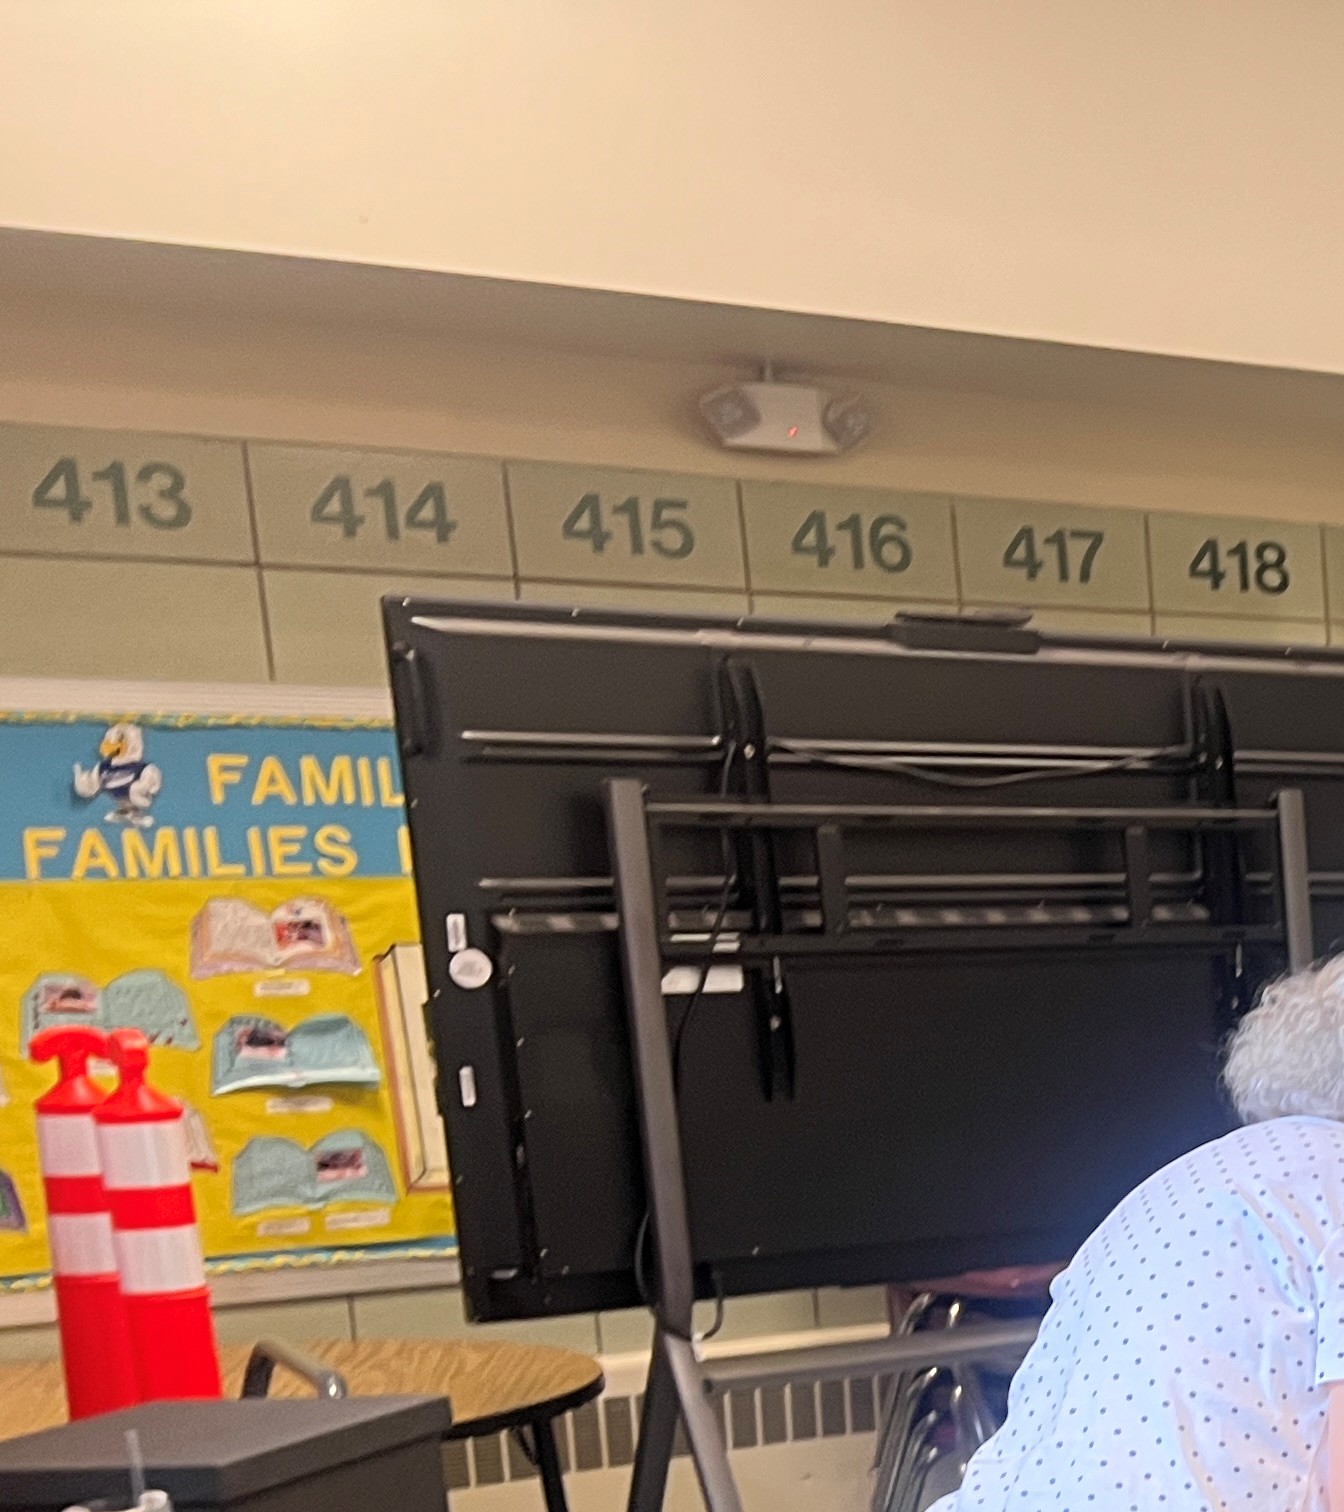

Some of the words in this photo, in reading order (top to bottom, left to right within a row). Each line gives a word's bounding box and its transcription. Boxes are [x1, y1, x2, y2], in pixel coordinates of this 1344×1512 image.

[32, 456, 192, 531] 413
[310, 475, 457, 545] 414
[562, 492, 696, 560] 415
[790, 508, 913, 574] 416
[1002, 524, 1106, 584] 417
[1188, 537, 1291, 595] 418
[22, 824, 358, 881] FAMILIES
